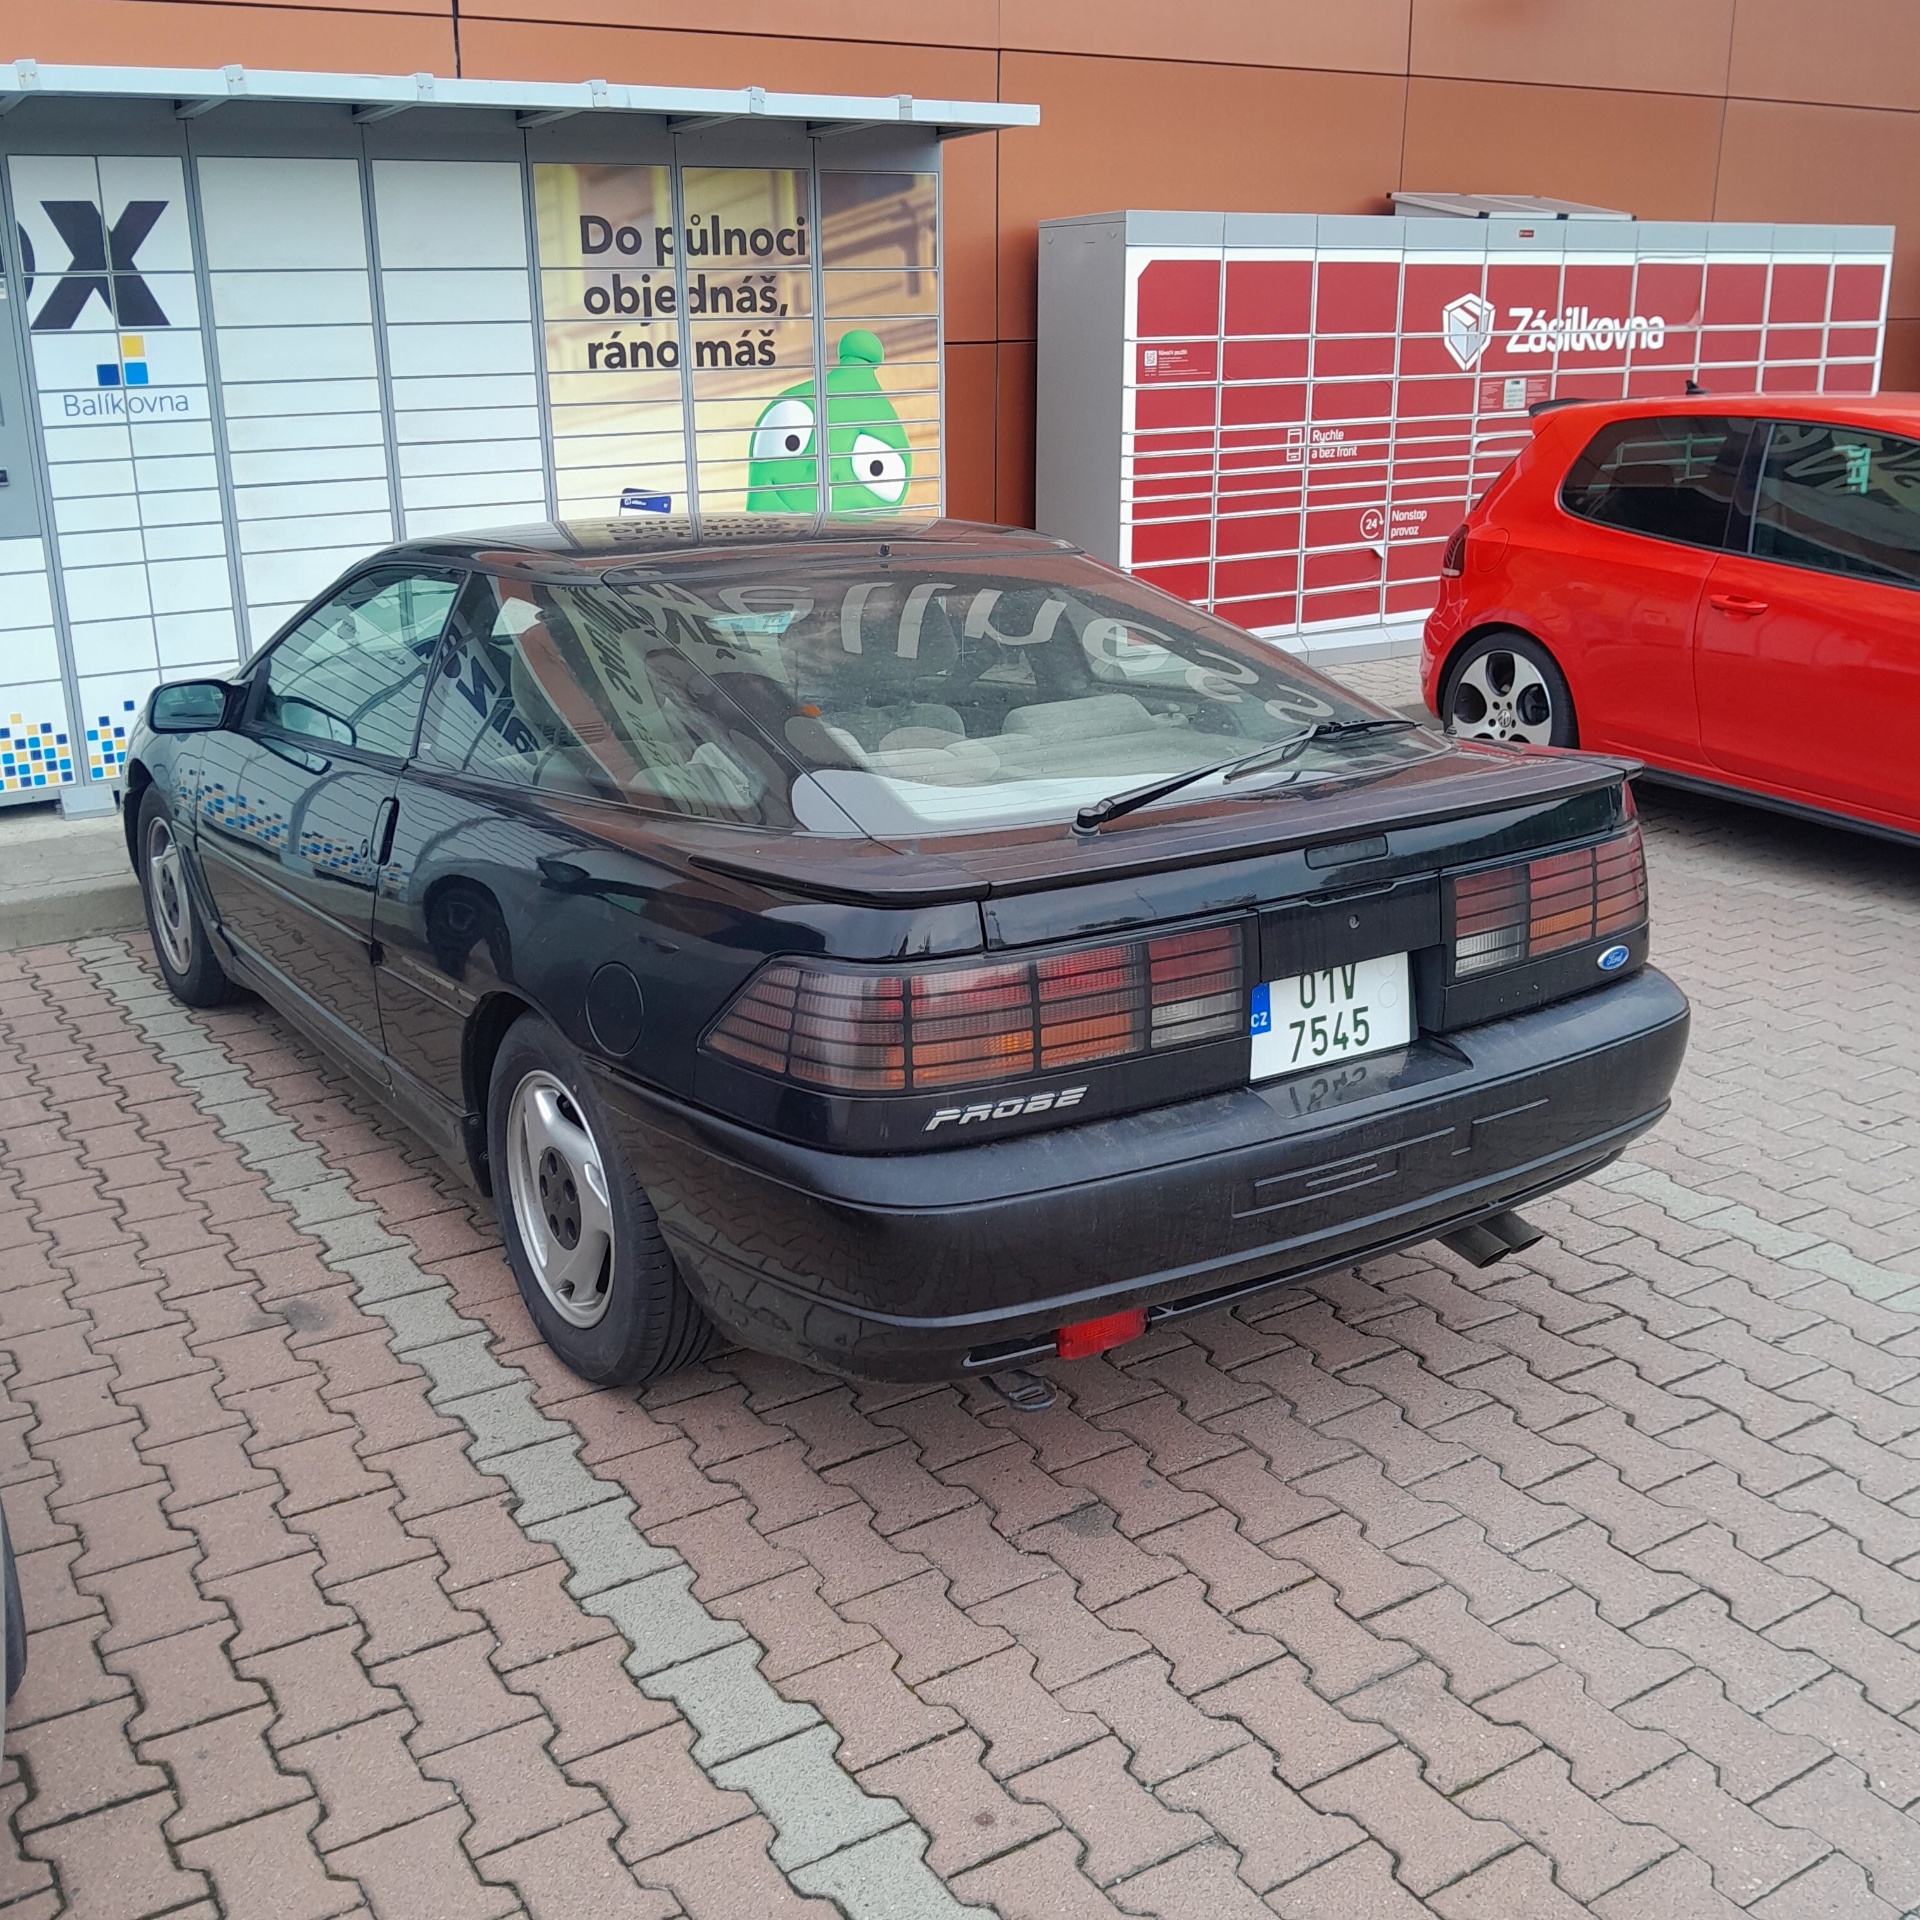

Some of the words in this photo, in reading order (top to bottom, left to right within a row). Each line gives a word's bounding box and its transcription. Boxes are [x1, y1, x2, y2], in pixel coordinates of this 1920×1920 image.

[580, 214, 643, 255] Do
[655, 214, 806, 267] půlnoci
[584, 273, 789, 327] objednáš,
[1506, 306, 1666, 354] Zásilkovna
[588, 330, 680, 369] ráno
[695, 328, 777, 367] máš
[63, 393, 190, 417] Balíkovna
[1311, 449, 1318, 459] a
[1319, 446, 1335, 459] bez
[1336, 445, 1358, 458] front
[1312, 430, 1344, 443] Rychle
[1365, 518, 1378, 530] 24
[1392, 509, 1428, 522] Nonstop
[1391, 525, 1420, 539] provoz
[1300, 963, 1357, 1010] 01V
[1251, 1011, 1268, 1028] CZ
[1289, 1005, 1370, 1063] 7545
[921, 1084, 1090, 1132] PROBE
